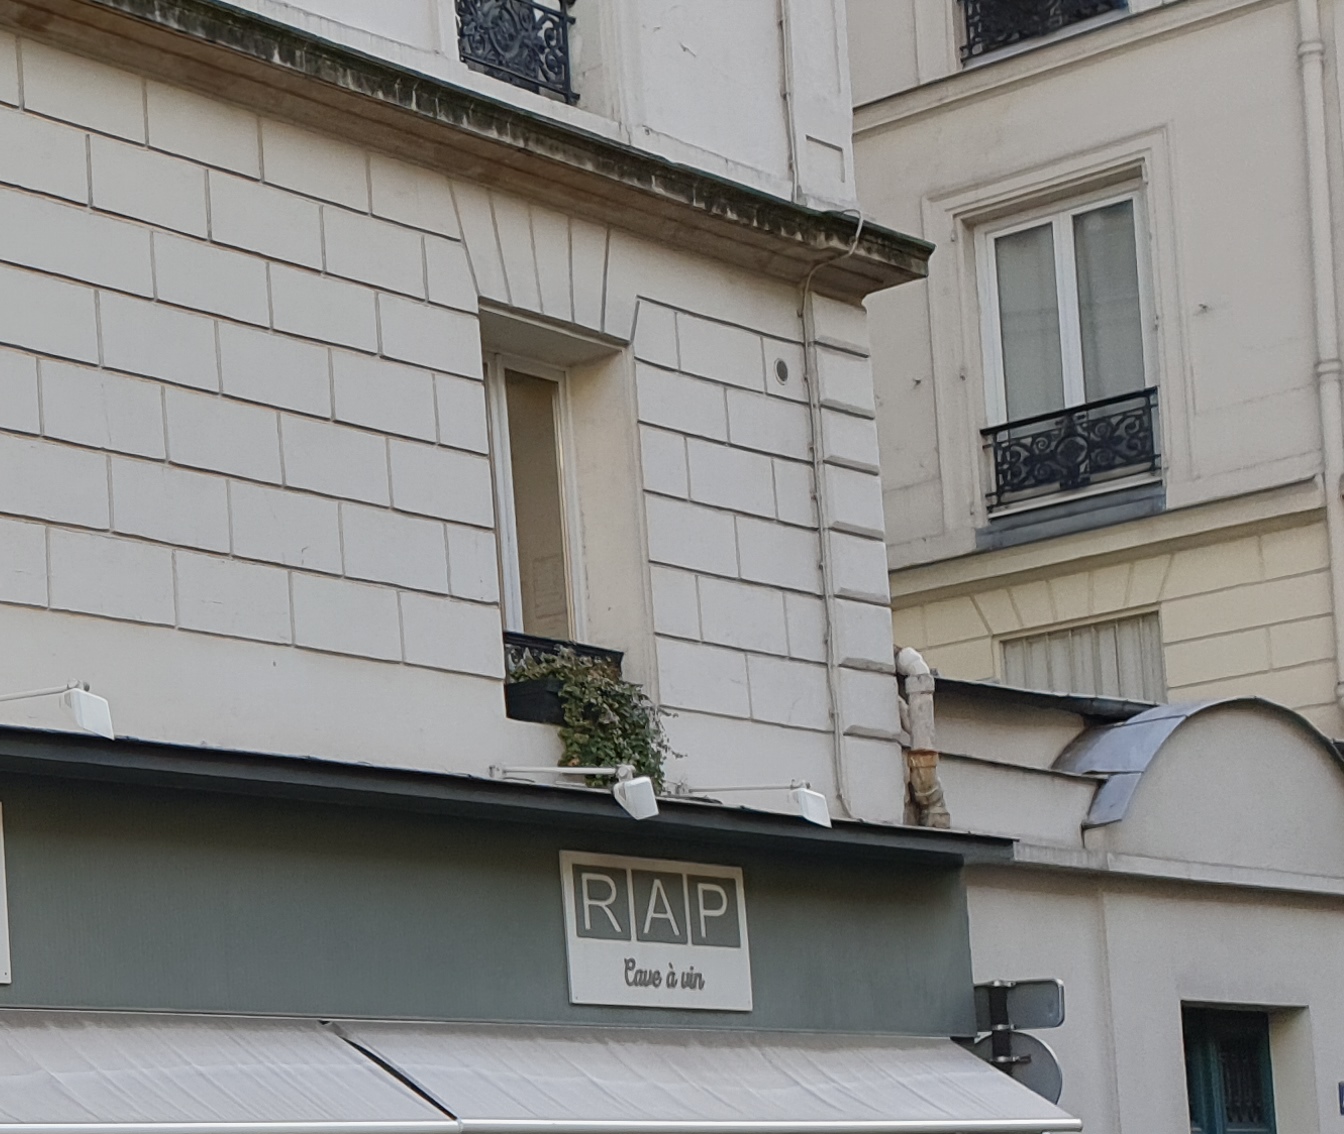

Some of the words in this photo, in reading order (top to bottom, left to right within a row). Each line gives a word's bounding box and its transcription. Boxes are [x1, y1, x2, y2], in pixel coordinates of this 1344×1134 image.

[581, 872, 728, 938] RAP
[623, 957, 662, 988] Cave
[666, 962, 678, 989] à
[680, 966, 705, 990] vin
